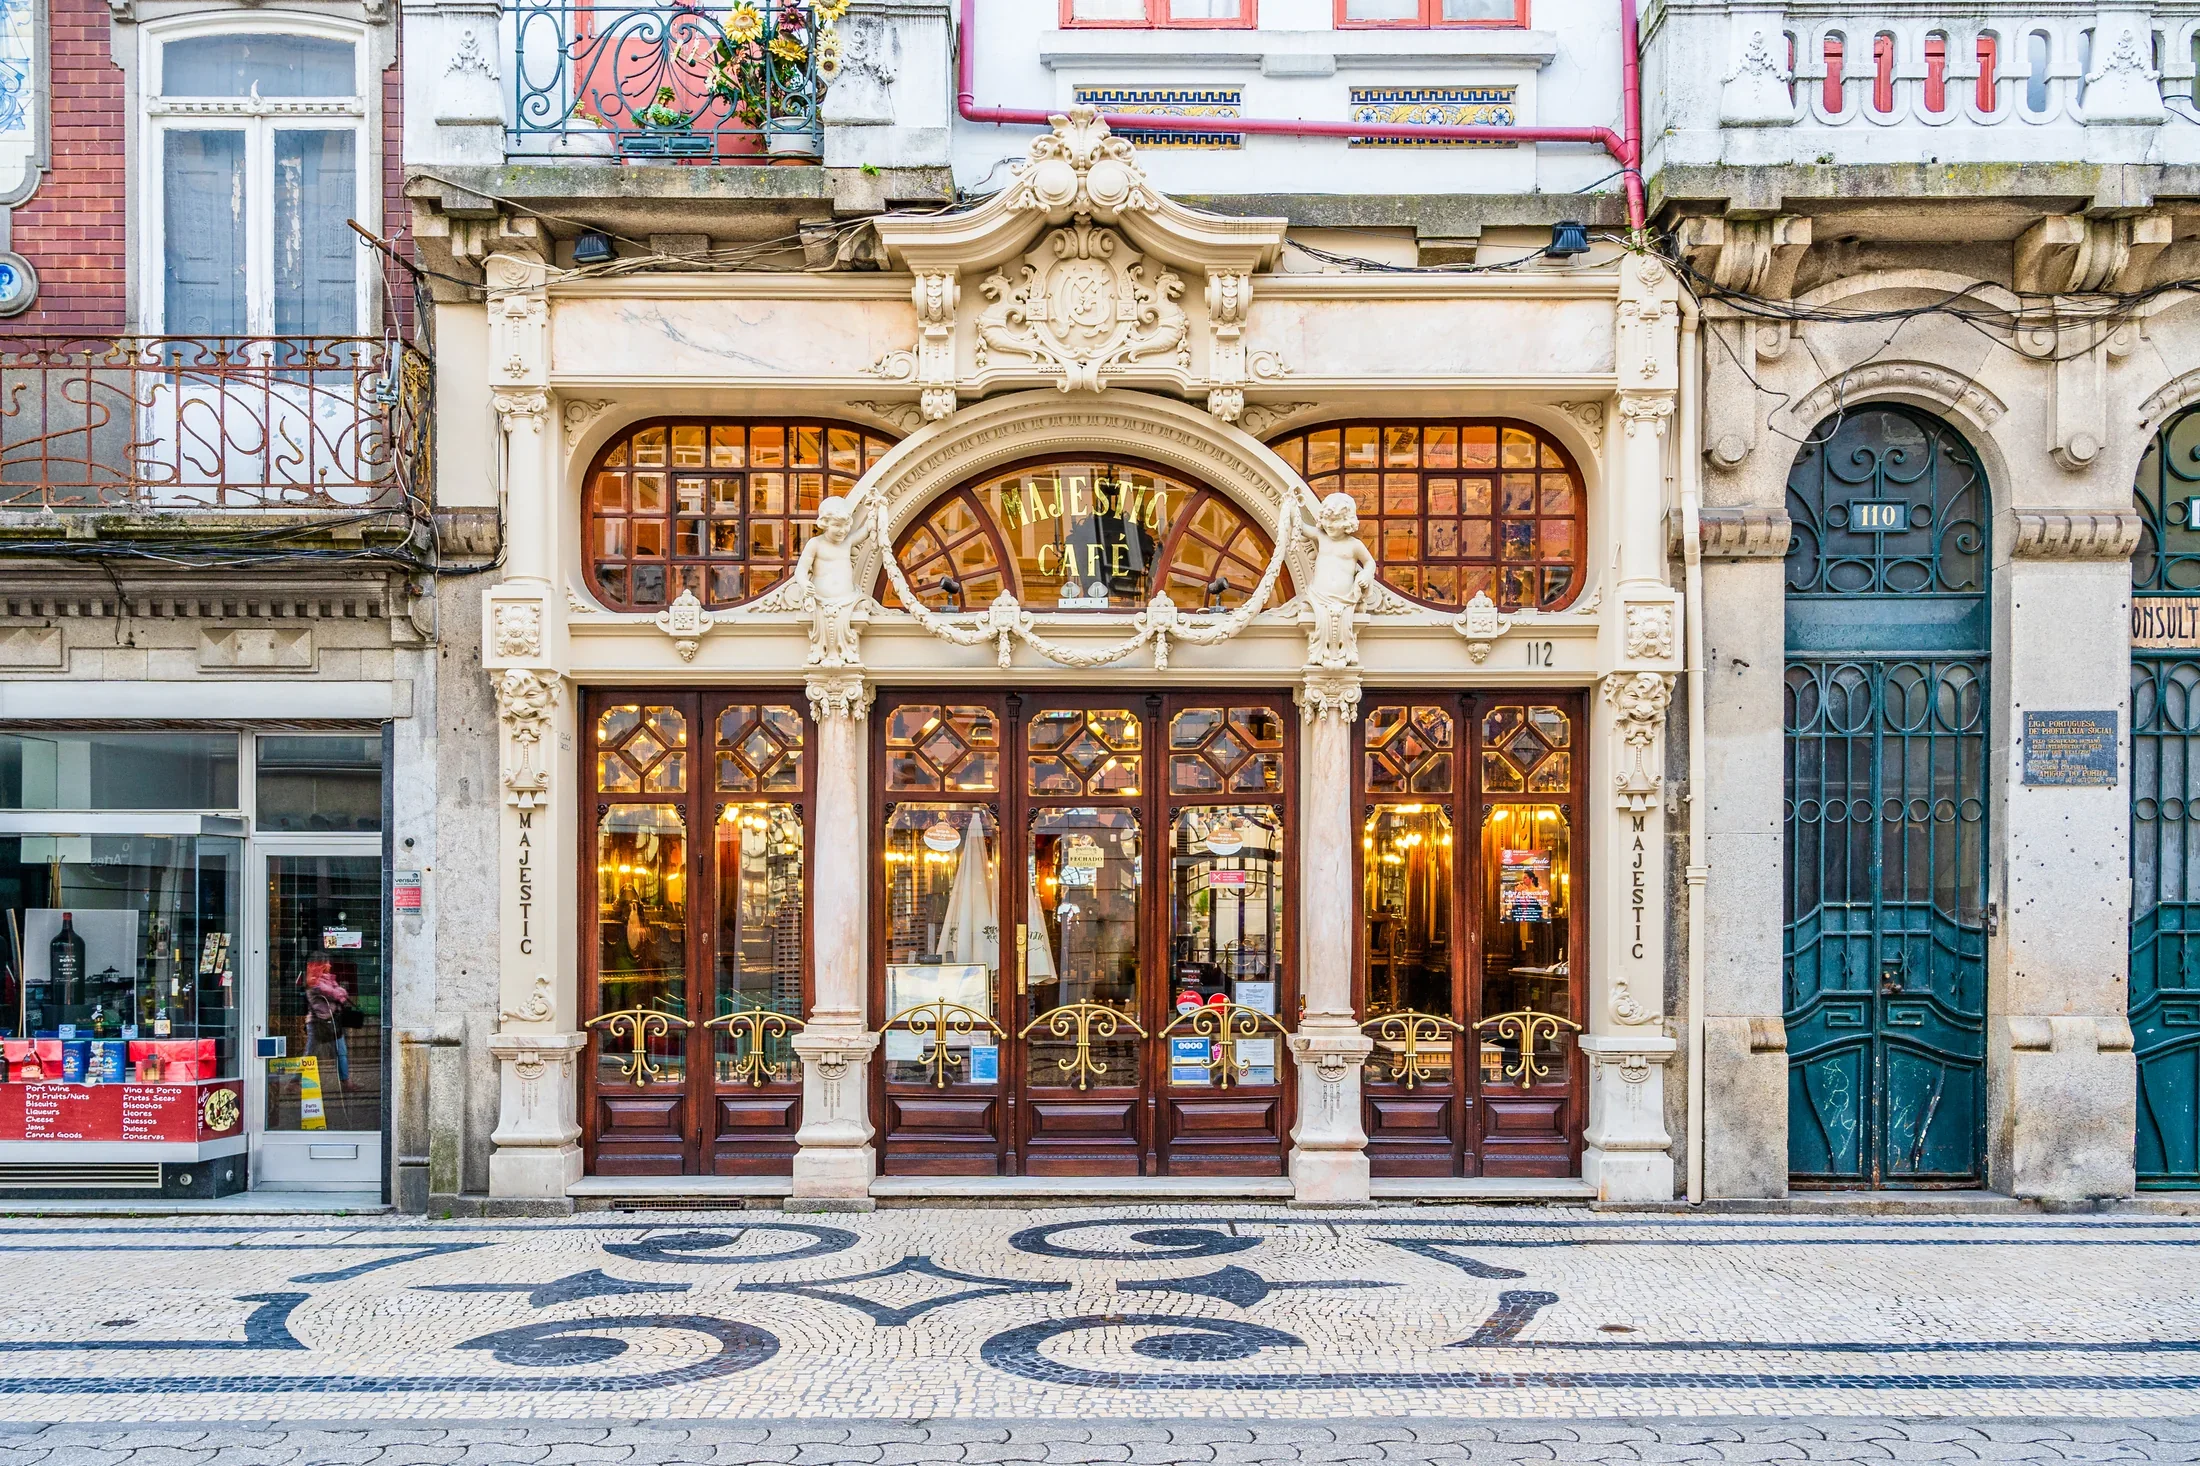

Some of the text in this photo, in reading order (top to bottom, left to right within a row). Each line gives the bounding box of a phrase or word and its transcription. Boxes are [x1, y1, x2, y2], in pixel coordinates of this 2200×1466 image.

[999, 476, 1169, 530] MAJESTIC
[1861, 505, 1896, 526] 110
[1038, 533, 1130, 577] CAFÉ
[1527, 641, 1553, 667] 112
[519, 812, 532, 955] MAJESTIC
[1632, 816, 1645, 959] MAJESTIC
[301, 1058, 315, 1067] bus
[152, 1094, 176, 1102] Secas
[123, 1117, 157, 1125] Quessos
